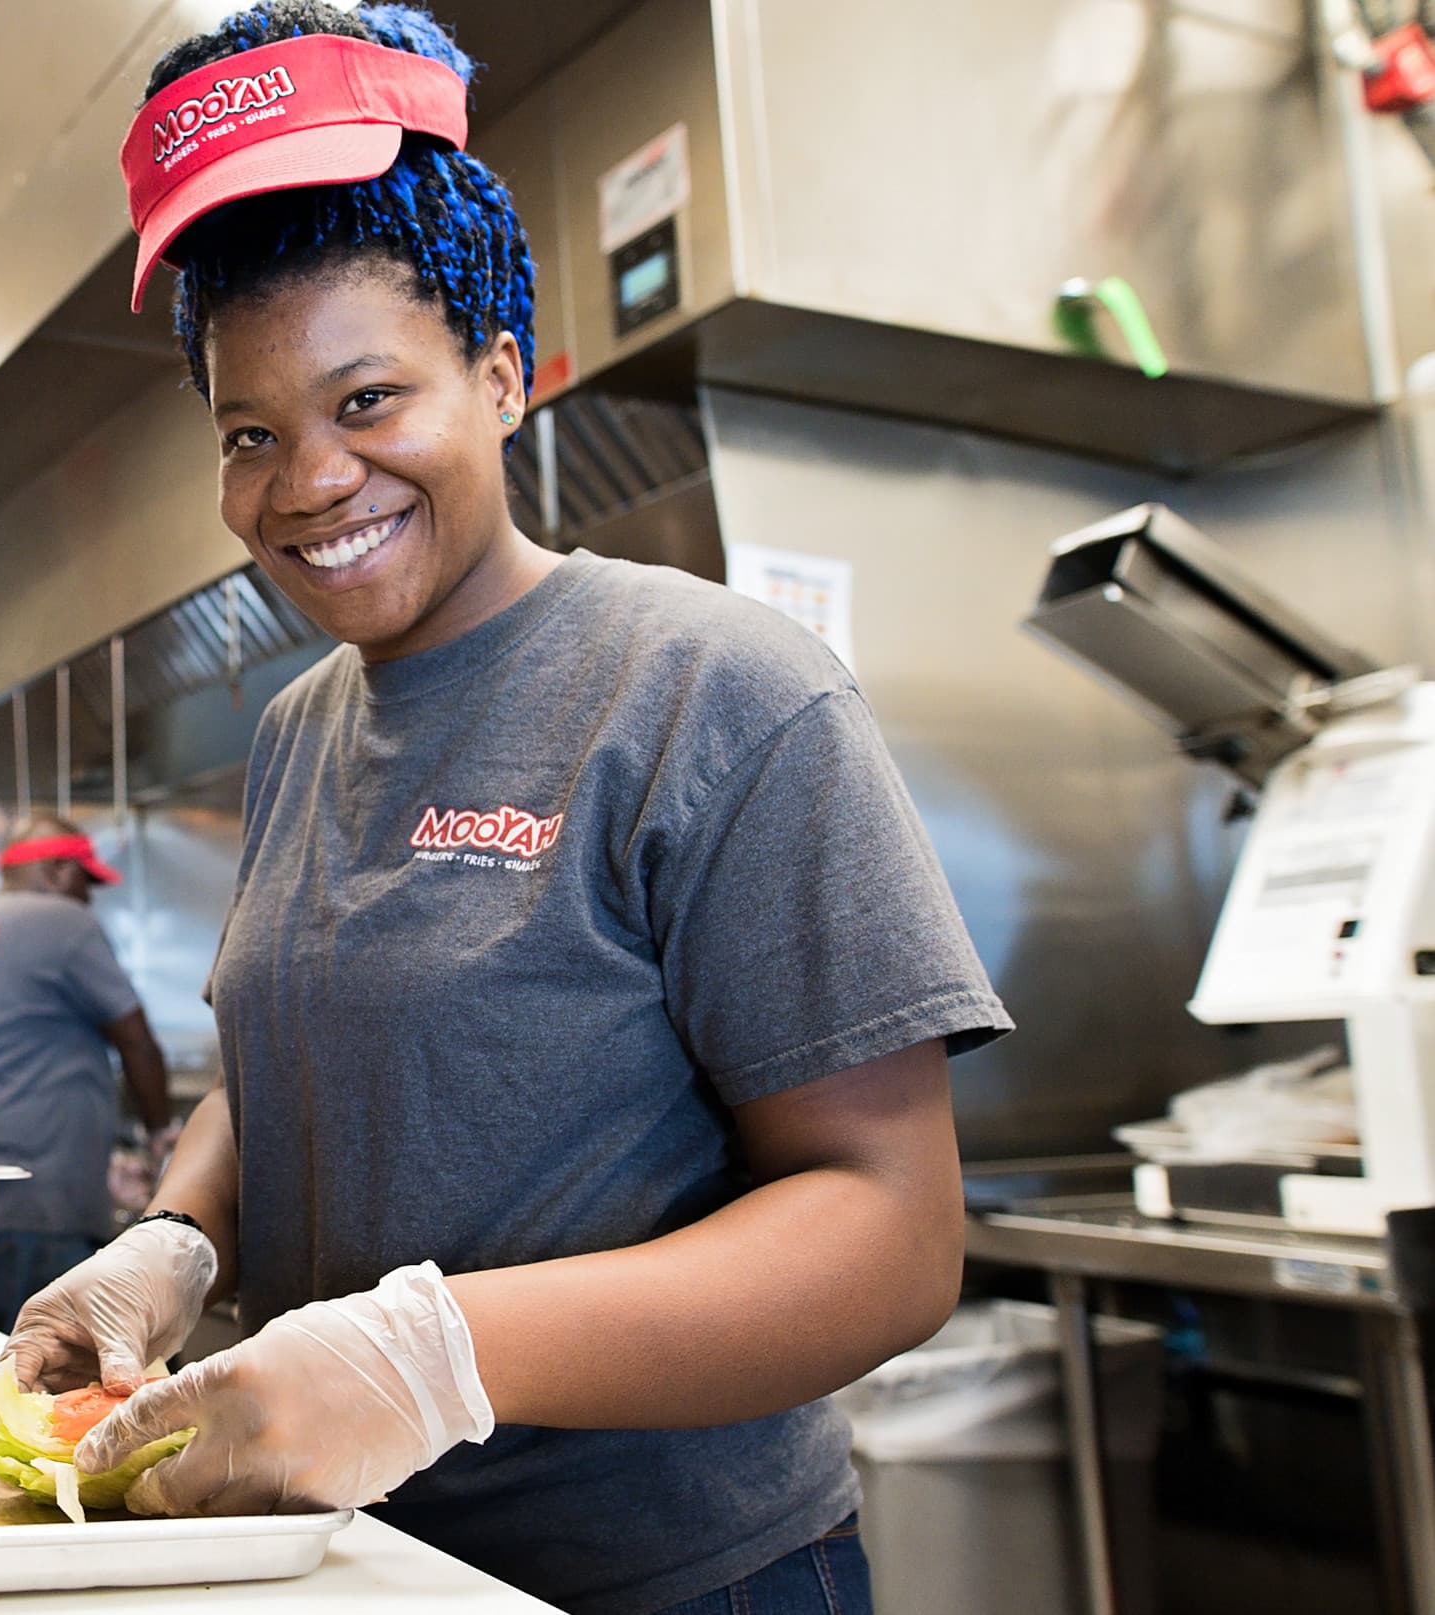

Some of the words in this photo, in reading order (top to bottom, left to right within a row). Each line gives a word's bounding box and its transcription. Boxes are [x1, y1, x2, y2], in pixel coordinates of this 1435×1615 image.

[153, 66, 296, 163] MOOYAH
[207, 121, 237, 141] FRIES
[244, 104, 286, 125] SHAKES
[410, 805, 564, 857] MOOYAH
[464, 853, 495, 868] FRIES
